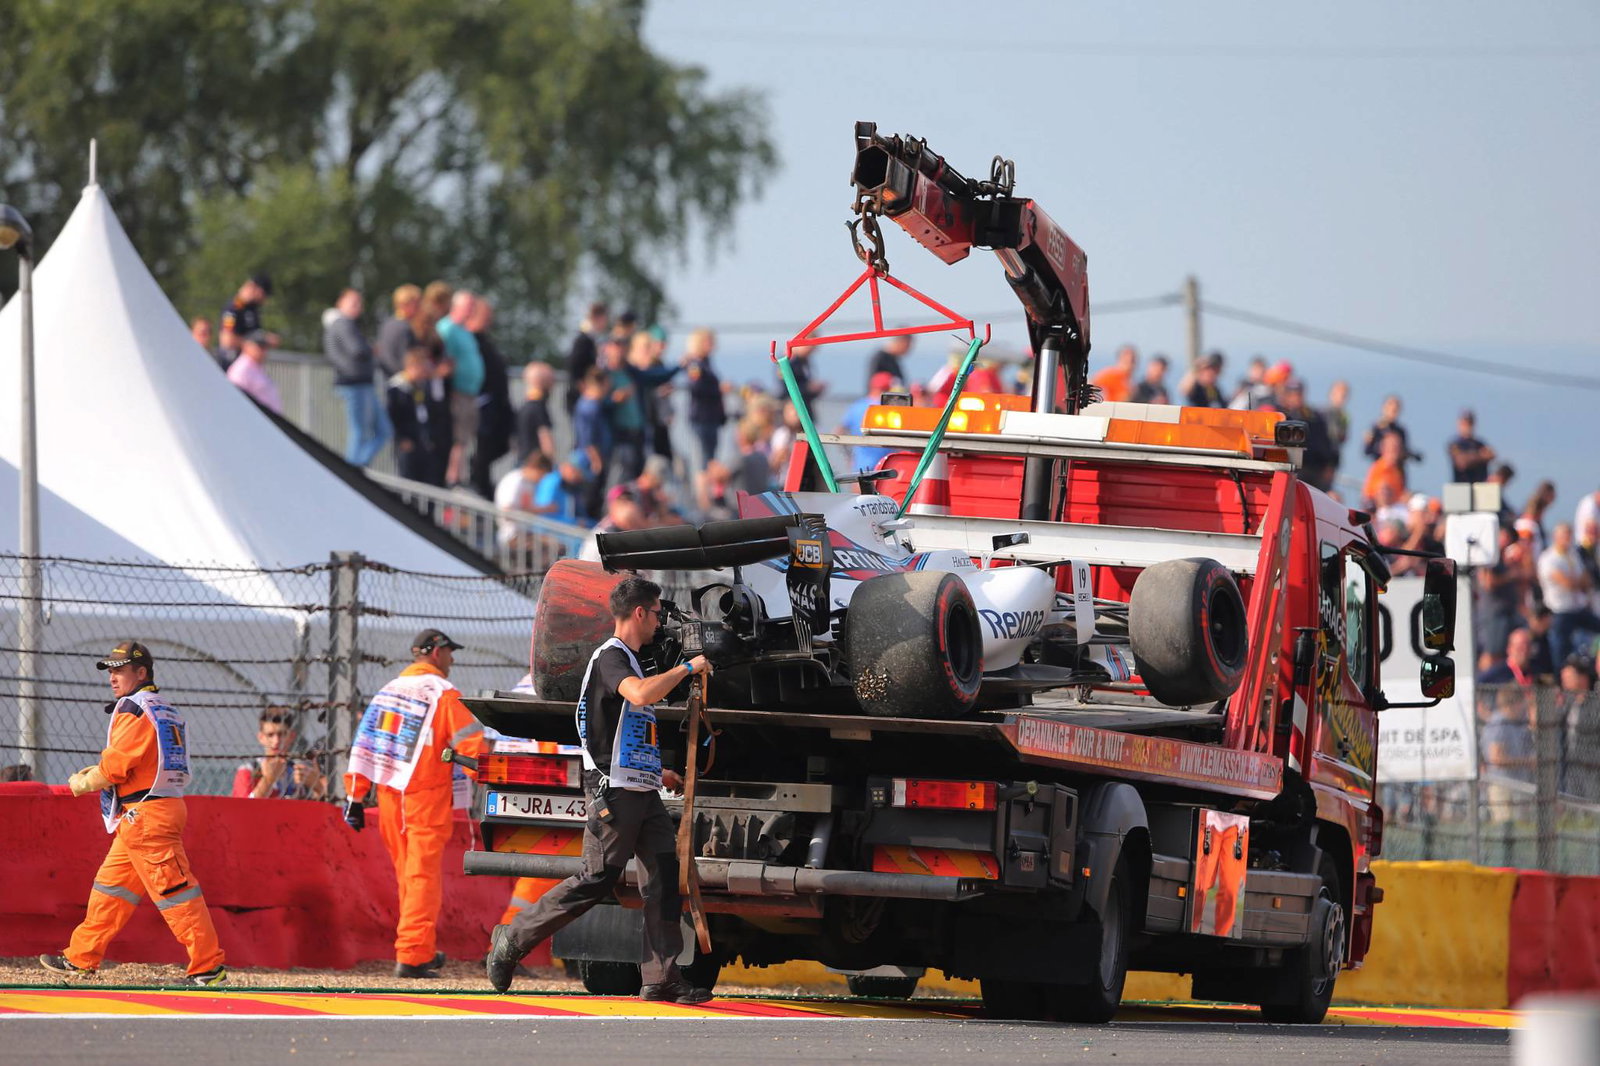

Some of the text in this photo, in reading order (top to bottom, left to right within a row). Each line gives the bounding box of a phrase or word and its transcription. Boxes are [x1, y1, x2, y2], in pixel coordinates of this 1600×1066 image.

[798, 545, 821, 564] JCB
[833, 550, 895, 571] RTINI
[1078, 568, 1086, 589] 19
[978, 609, 1045, 639] Rexona
[1018, 720, 1071, 754] DEPANNAGE
[1071, 728, 1095, 758] JOUR
[1096, 732, 1103, 759] &
[1104, 733, 1126, 762] NUIT
[1404, 730, 1424, 744] DE
[1430, 729, 1461, 743] SPA
[489, 805, 495, 813] B
[501, 795, 587, 817] 1-JRA-43
